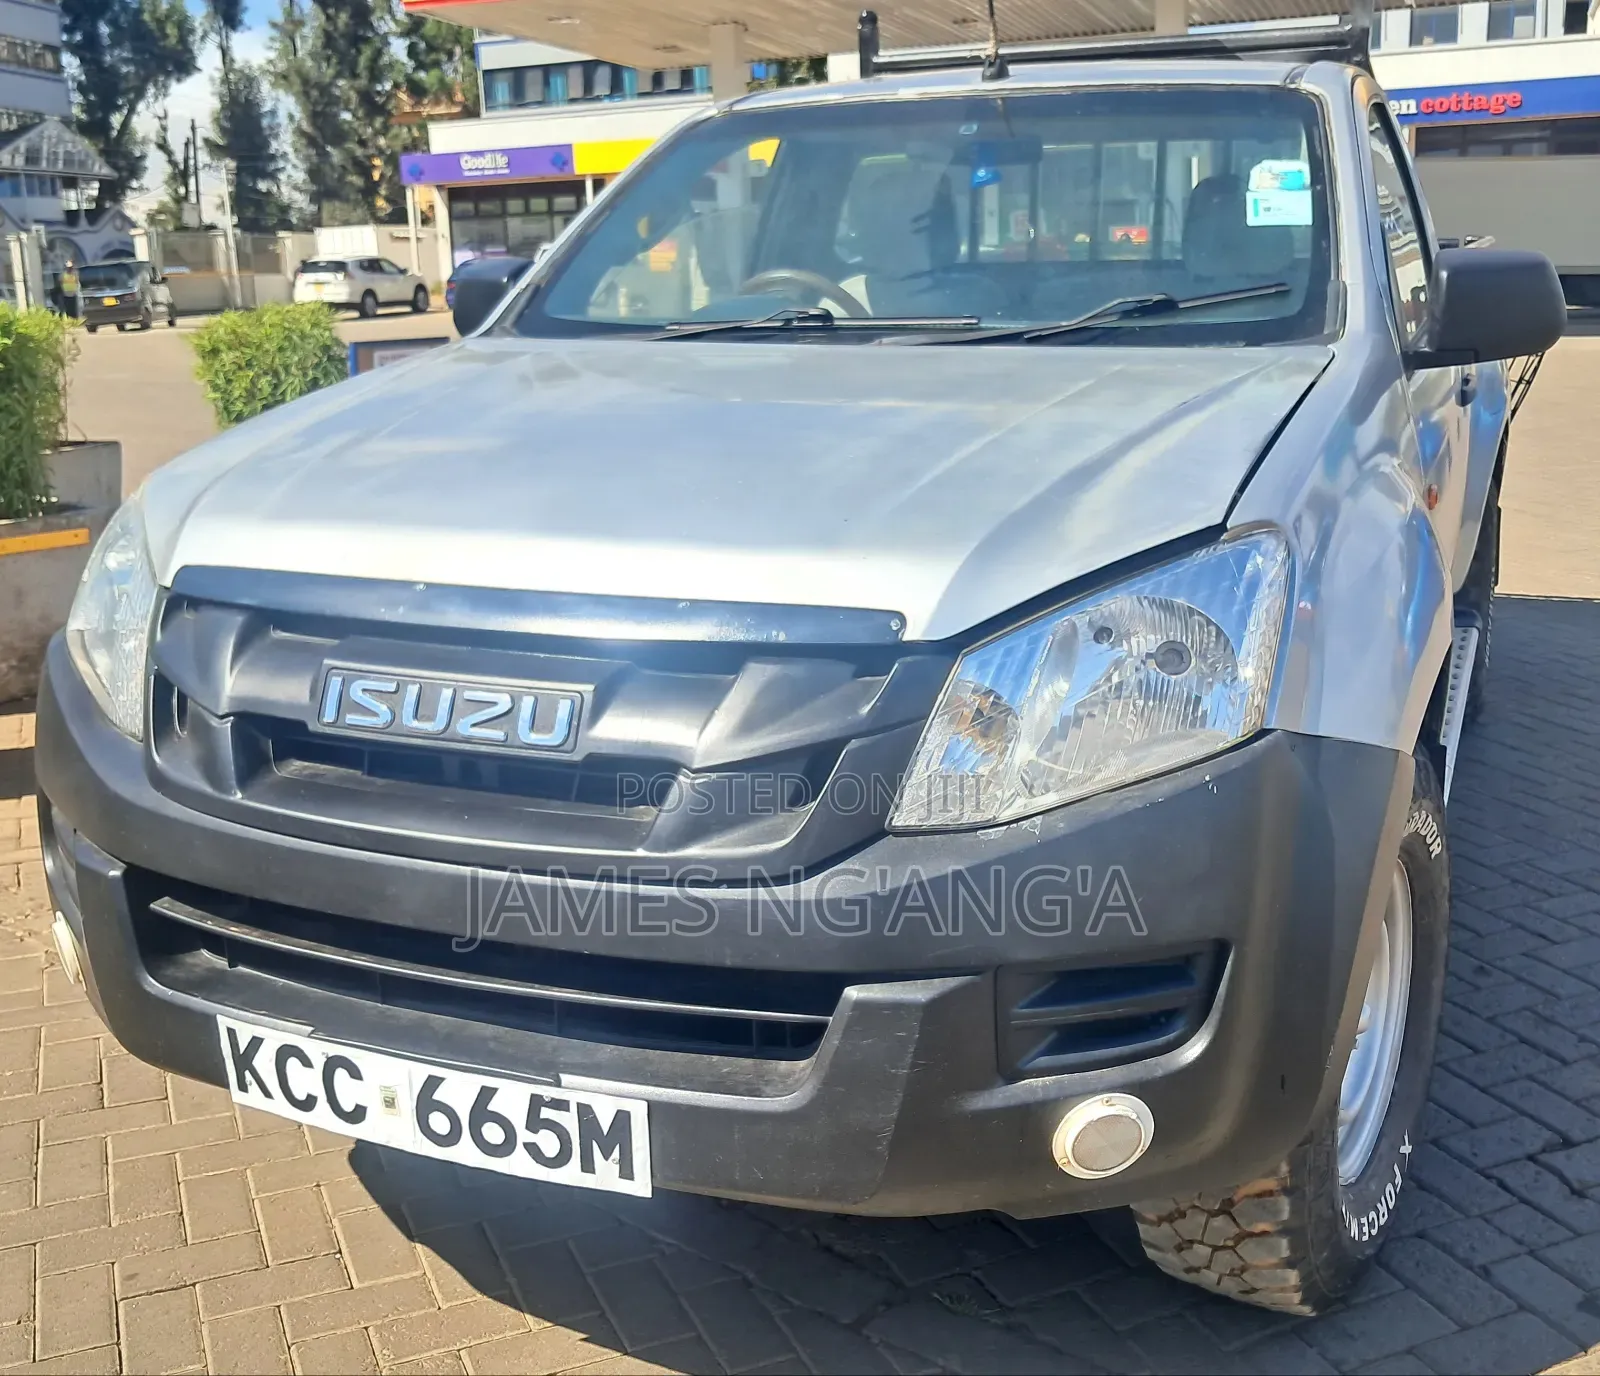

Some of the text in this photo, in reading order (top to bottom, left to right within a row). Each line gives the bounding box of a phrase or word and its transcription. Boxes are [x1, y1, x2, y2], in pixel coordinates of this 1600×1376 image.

[1388, 91, 1523, 116] en cottage
[322, 675, 575, 747] ISUZU
[226, 1026, 635, 1182] KCC 665M
